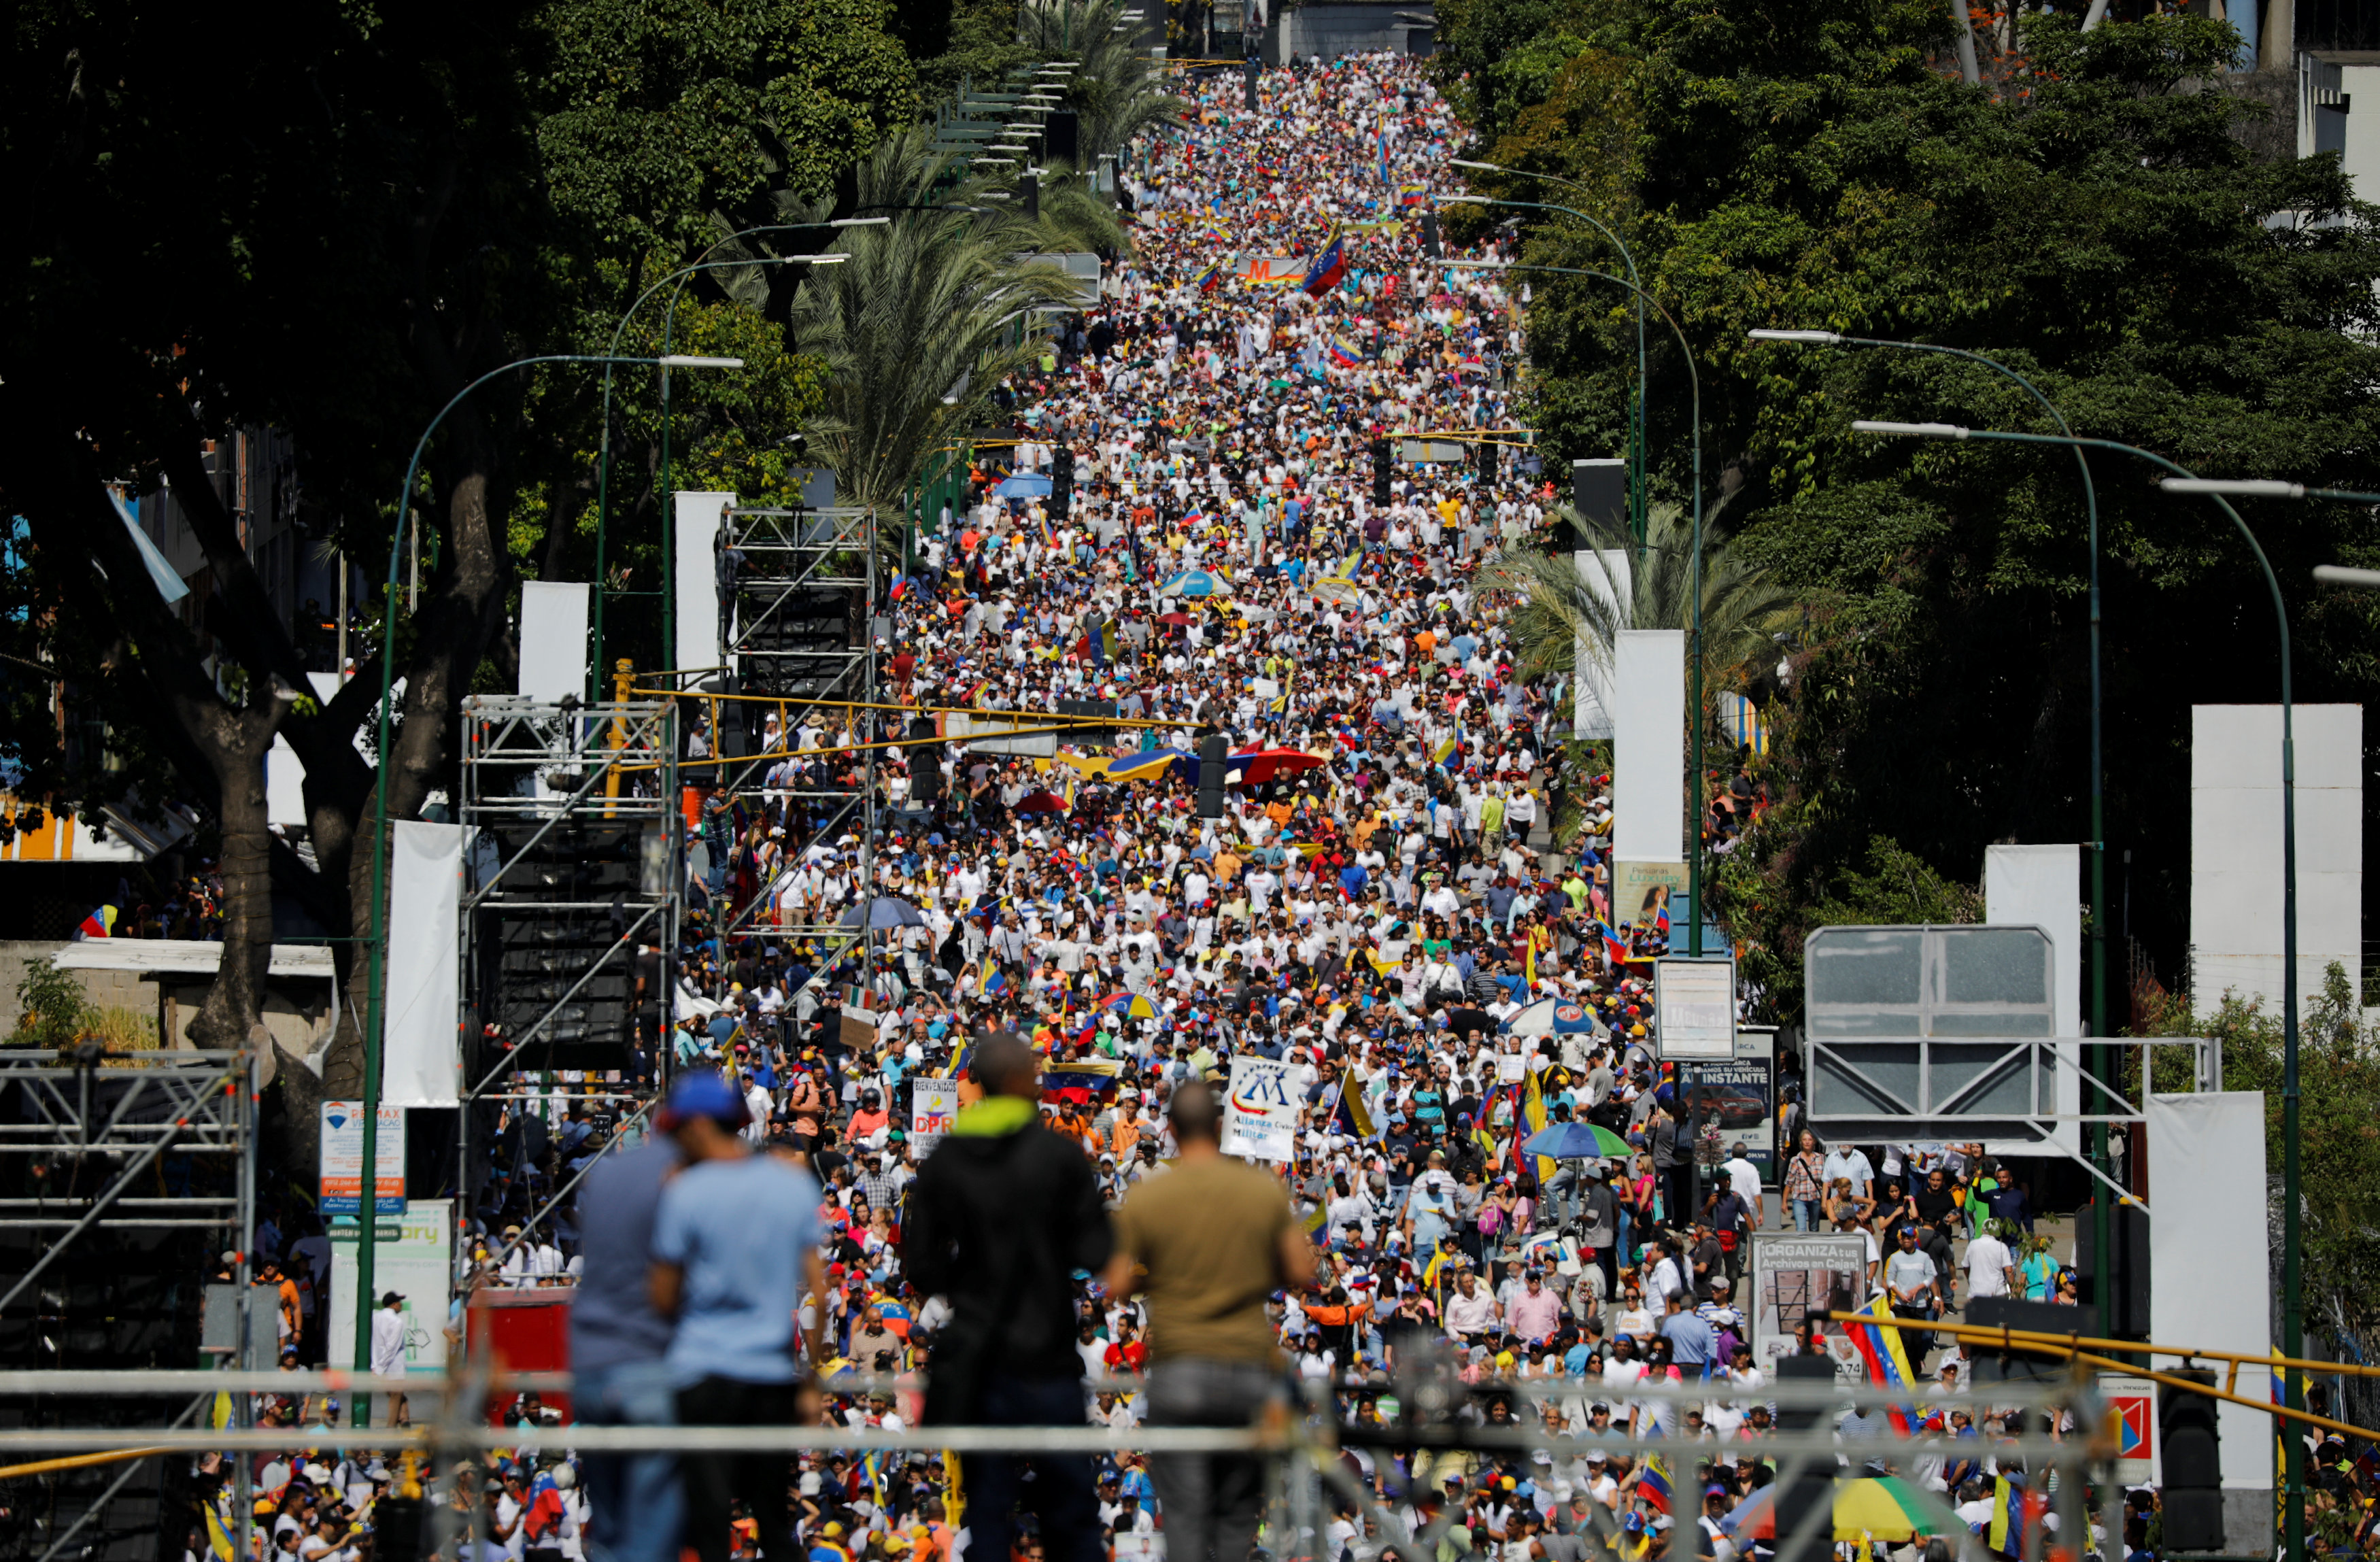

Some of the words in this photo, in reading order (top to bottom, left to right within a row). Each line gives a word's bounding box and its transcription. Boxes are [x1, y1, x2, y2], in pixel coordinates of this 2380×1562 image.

[1629, 875, 1681, 883] LUXURY
[1734, 1065, 1766, 1073] VEHÍCULO
[1702, 1073, 1768, 1084] INSTANTE
[915, 1116, 955, 1134] DPR
[1233, 1128, 1268, 1140] Militar
[1761, 1244, 1837, 1257] ¡ORGANIZA
[1762, 1259, 1809, 1268] Archivos
[1826, 1259, 1860, 1271] Cajas!
